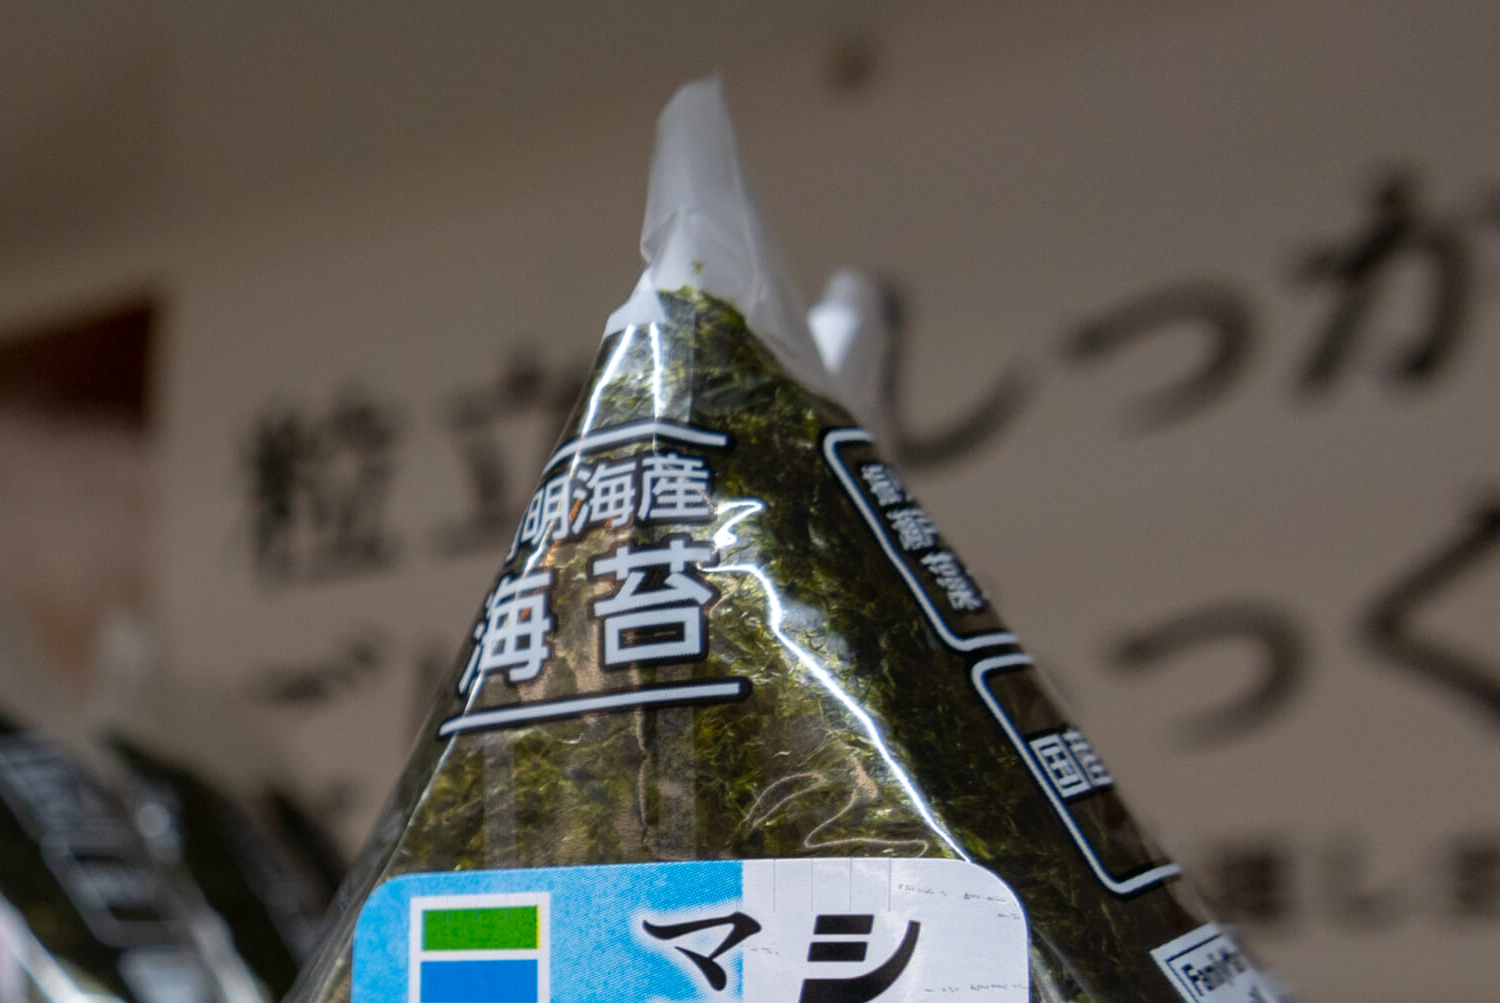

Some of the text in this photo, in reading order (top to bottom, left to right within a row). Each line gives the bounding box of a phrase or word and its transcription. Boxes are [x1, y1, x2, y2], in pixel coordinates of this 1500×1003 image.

[506, 454, 709, 562] 明海産
[458, 540, 714, 693] 海苔
